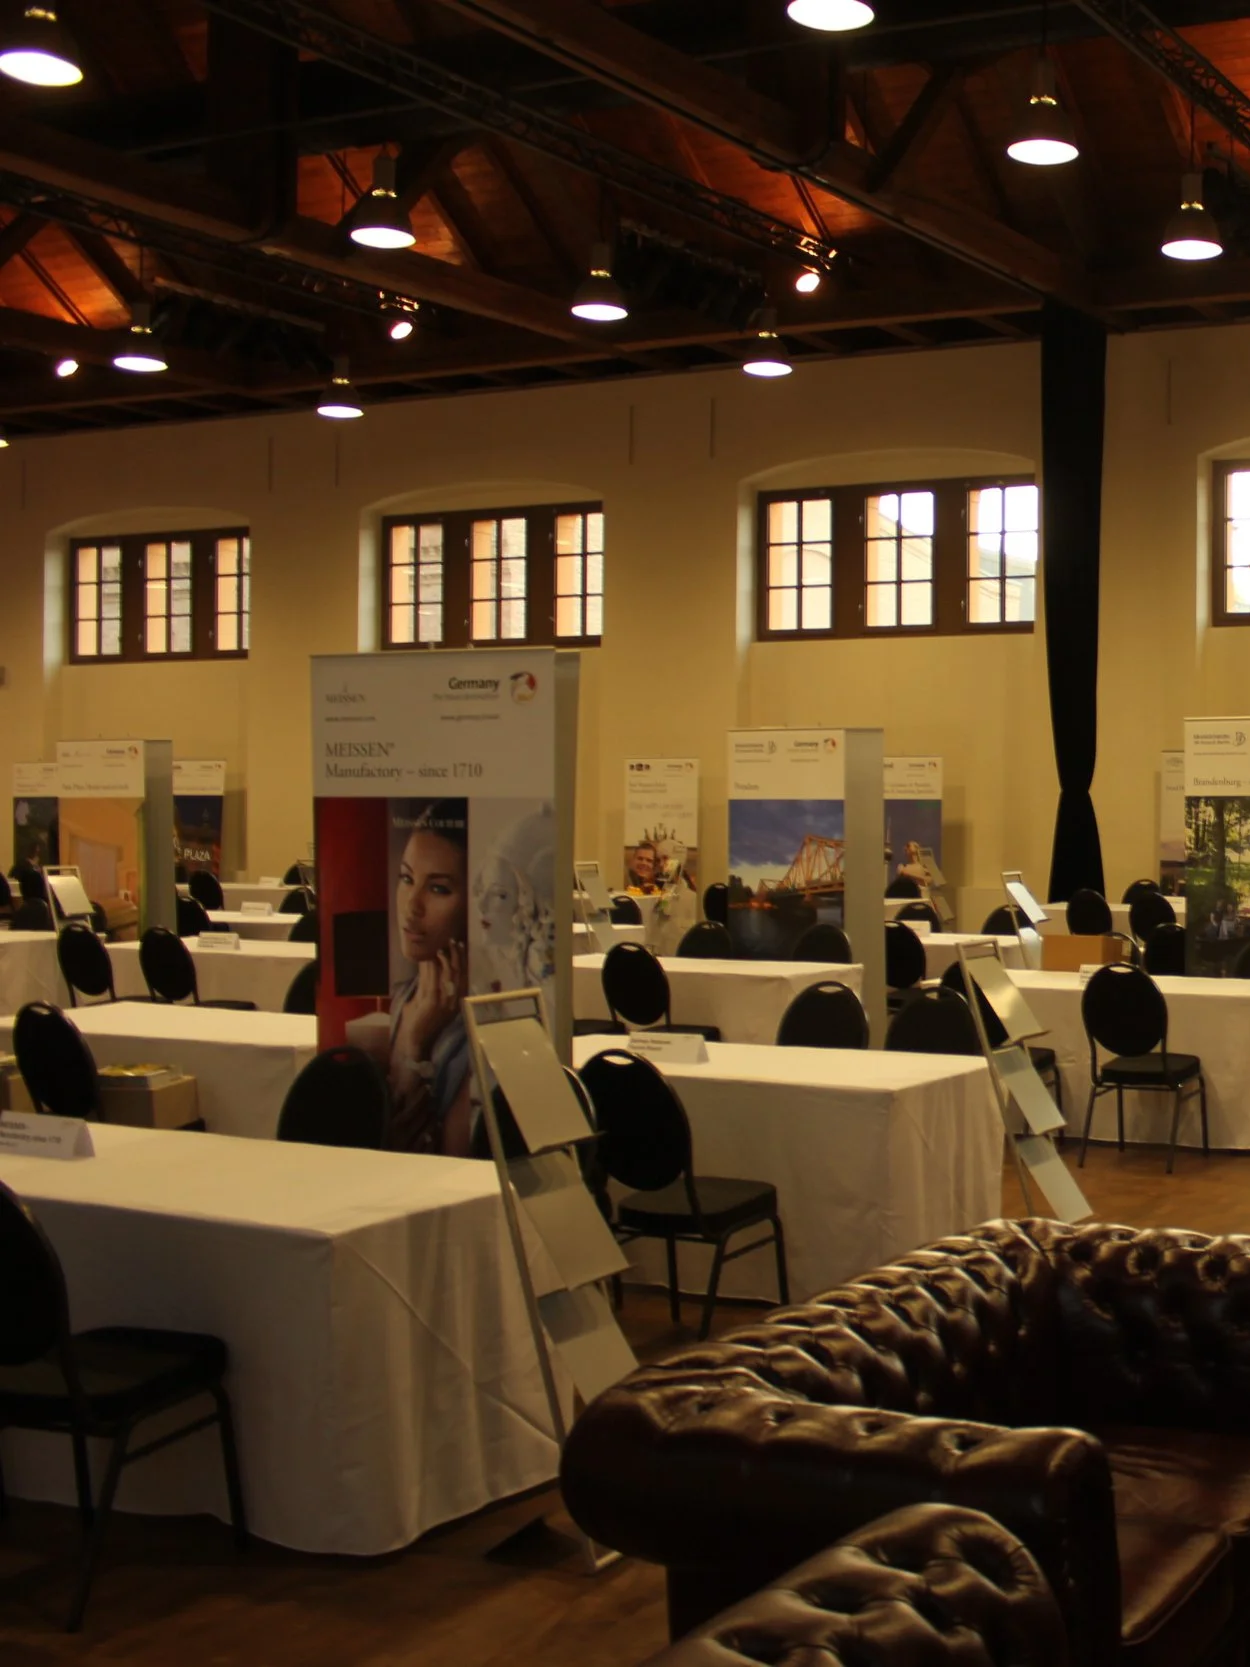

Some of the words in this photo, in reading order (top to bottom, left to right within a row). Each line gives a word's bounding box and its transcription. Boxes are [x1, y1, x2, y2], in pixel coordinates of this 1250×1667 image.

[448, 676, 500, 692] Germany
[325, 763, 401, 782] Manufactory
[418, 764, 448, 778] since
[452, 763, 483, 778] 1710
